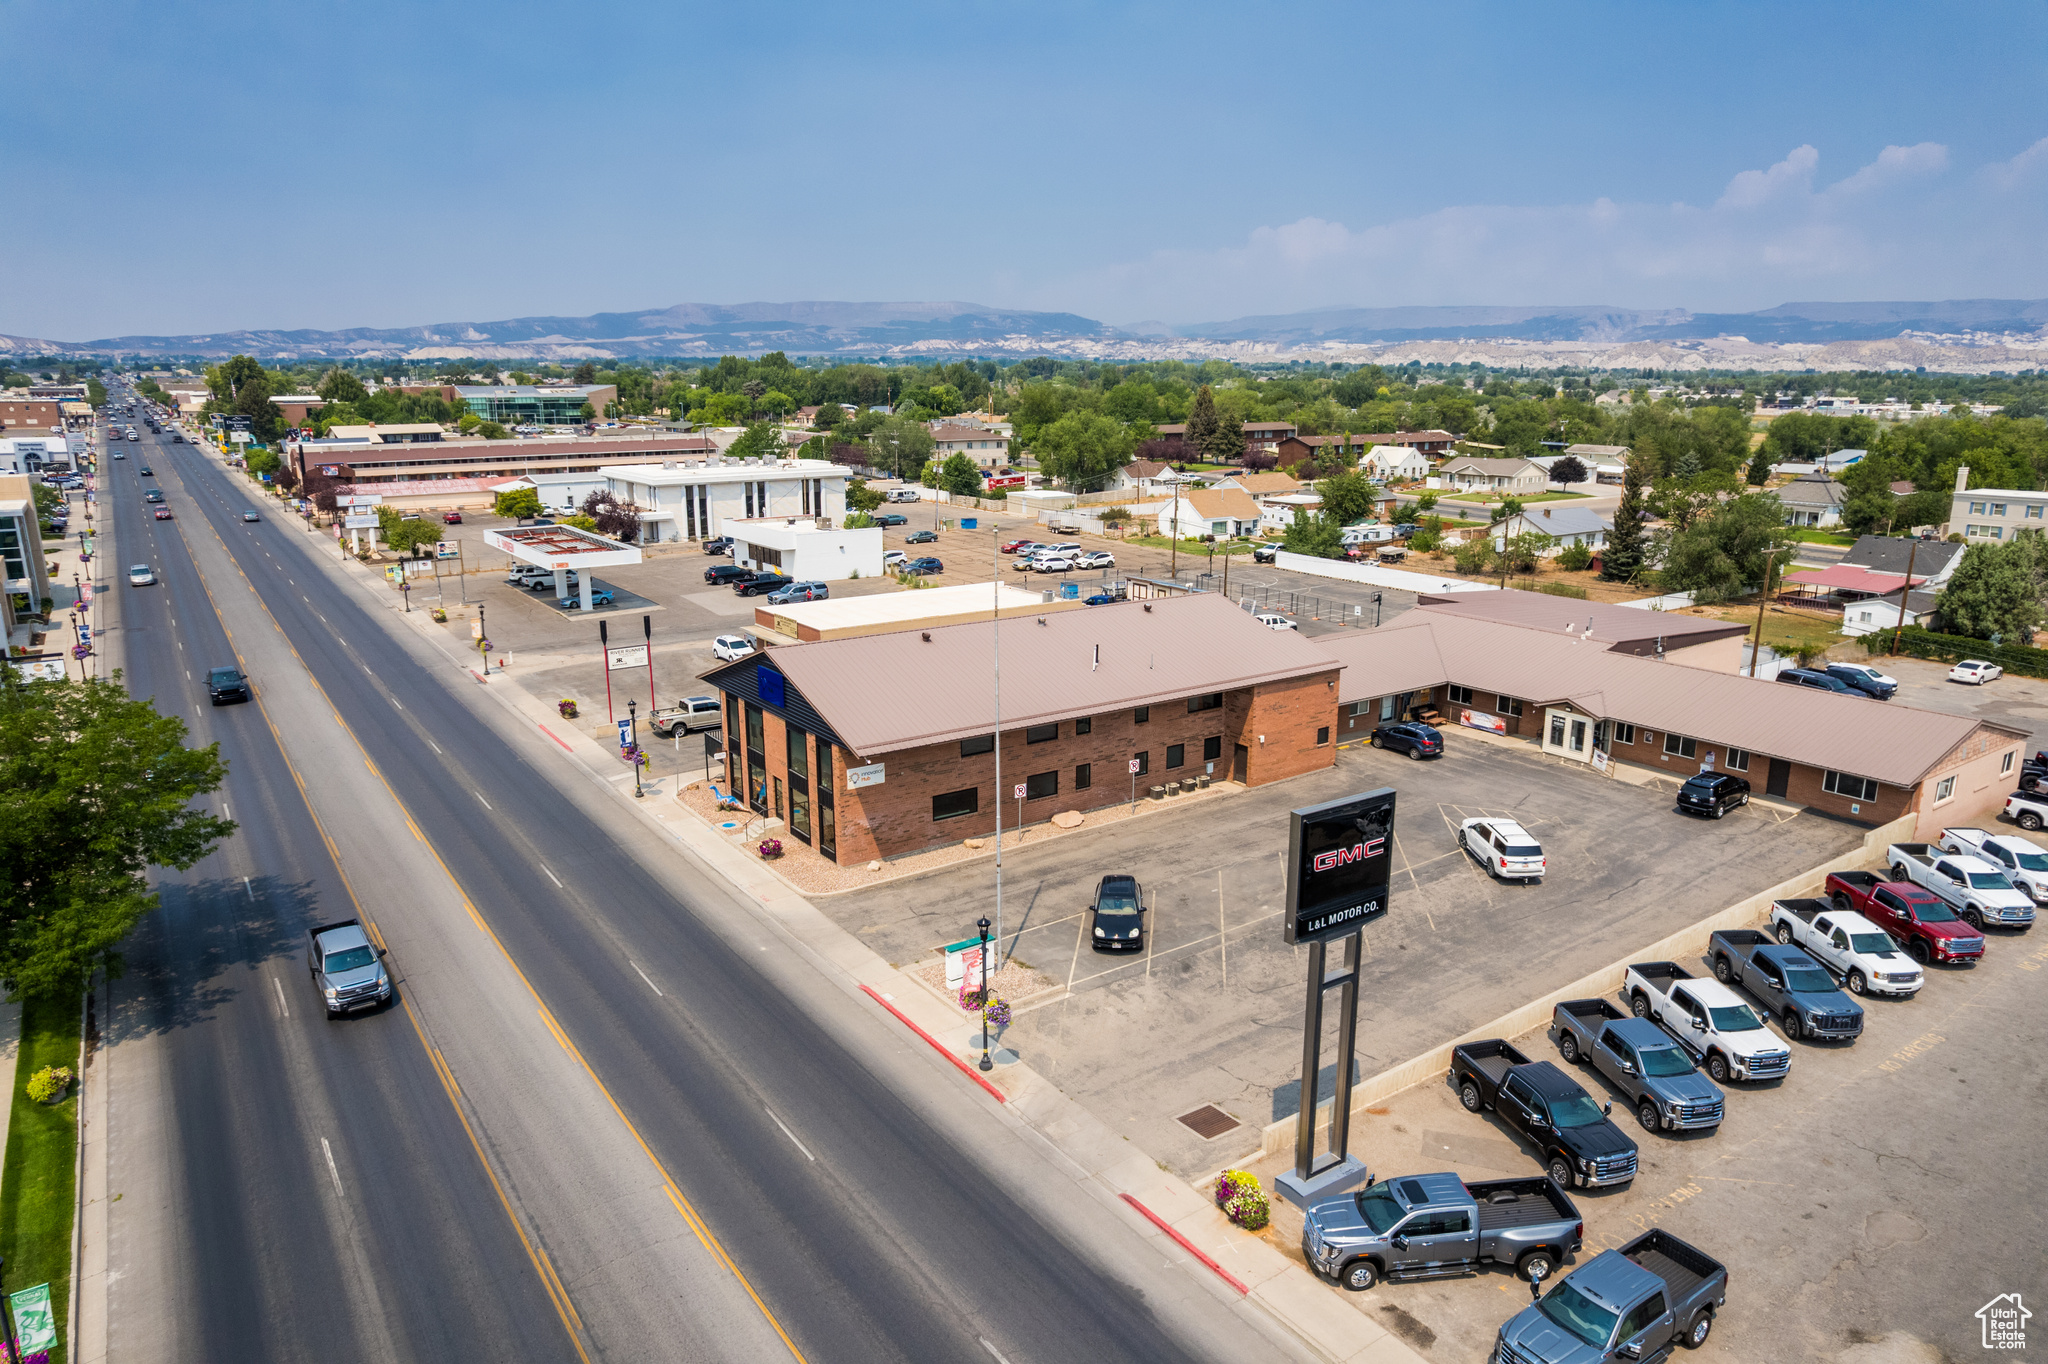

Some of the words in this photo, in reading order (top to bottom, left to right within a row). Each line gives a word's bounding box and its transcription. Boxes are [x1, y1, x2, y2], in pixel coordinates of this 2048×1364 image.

[1314, 837, 1385, 872] GMC
[1308, 917, 1326, 931] L&L
[1328, 905, 1362, 925] MOTOR
[1363, 900, 1379, 914] CO.
[1878, 1060, 1902, 1073] NO
[1893, 1033, 1946, 1063] PARKING
